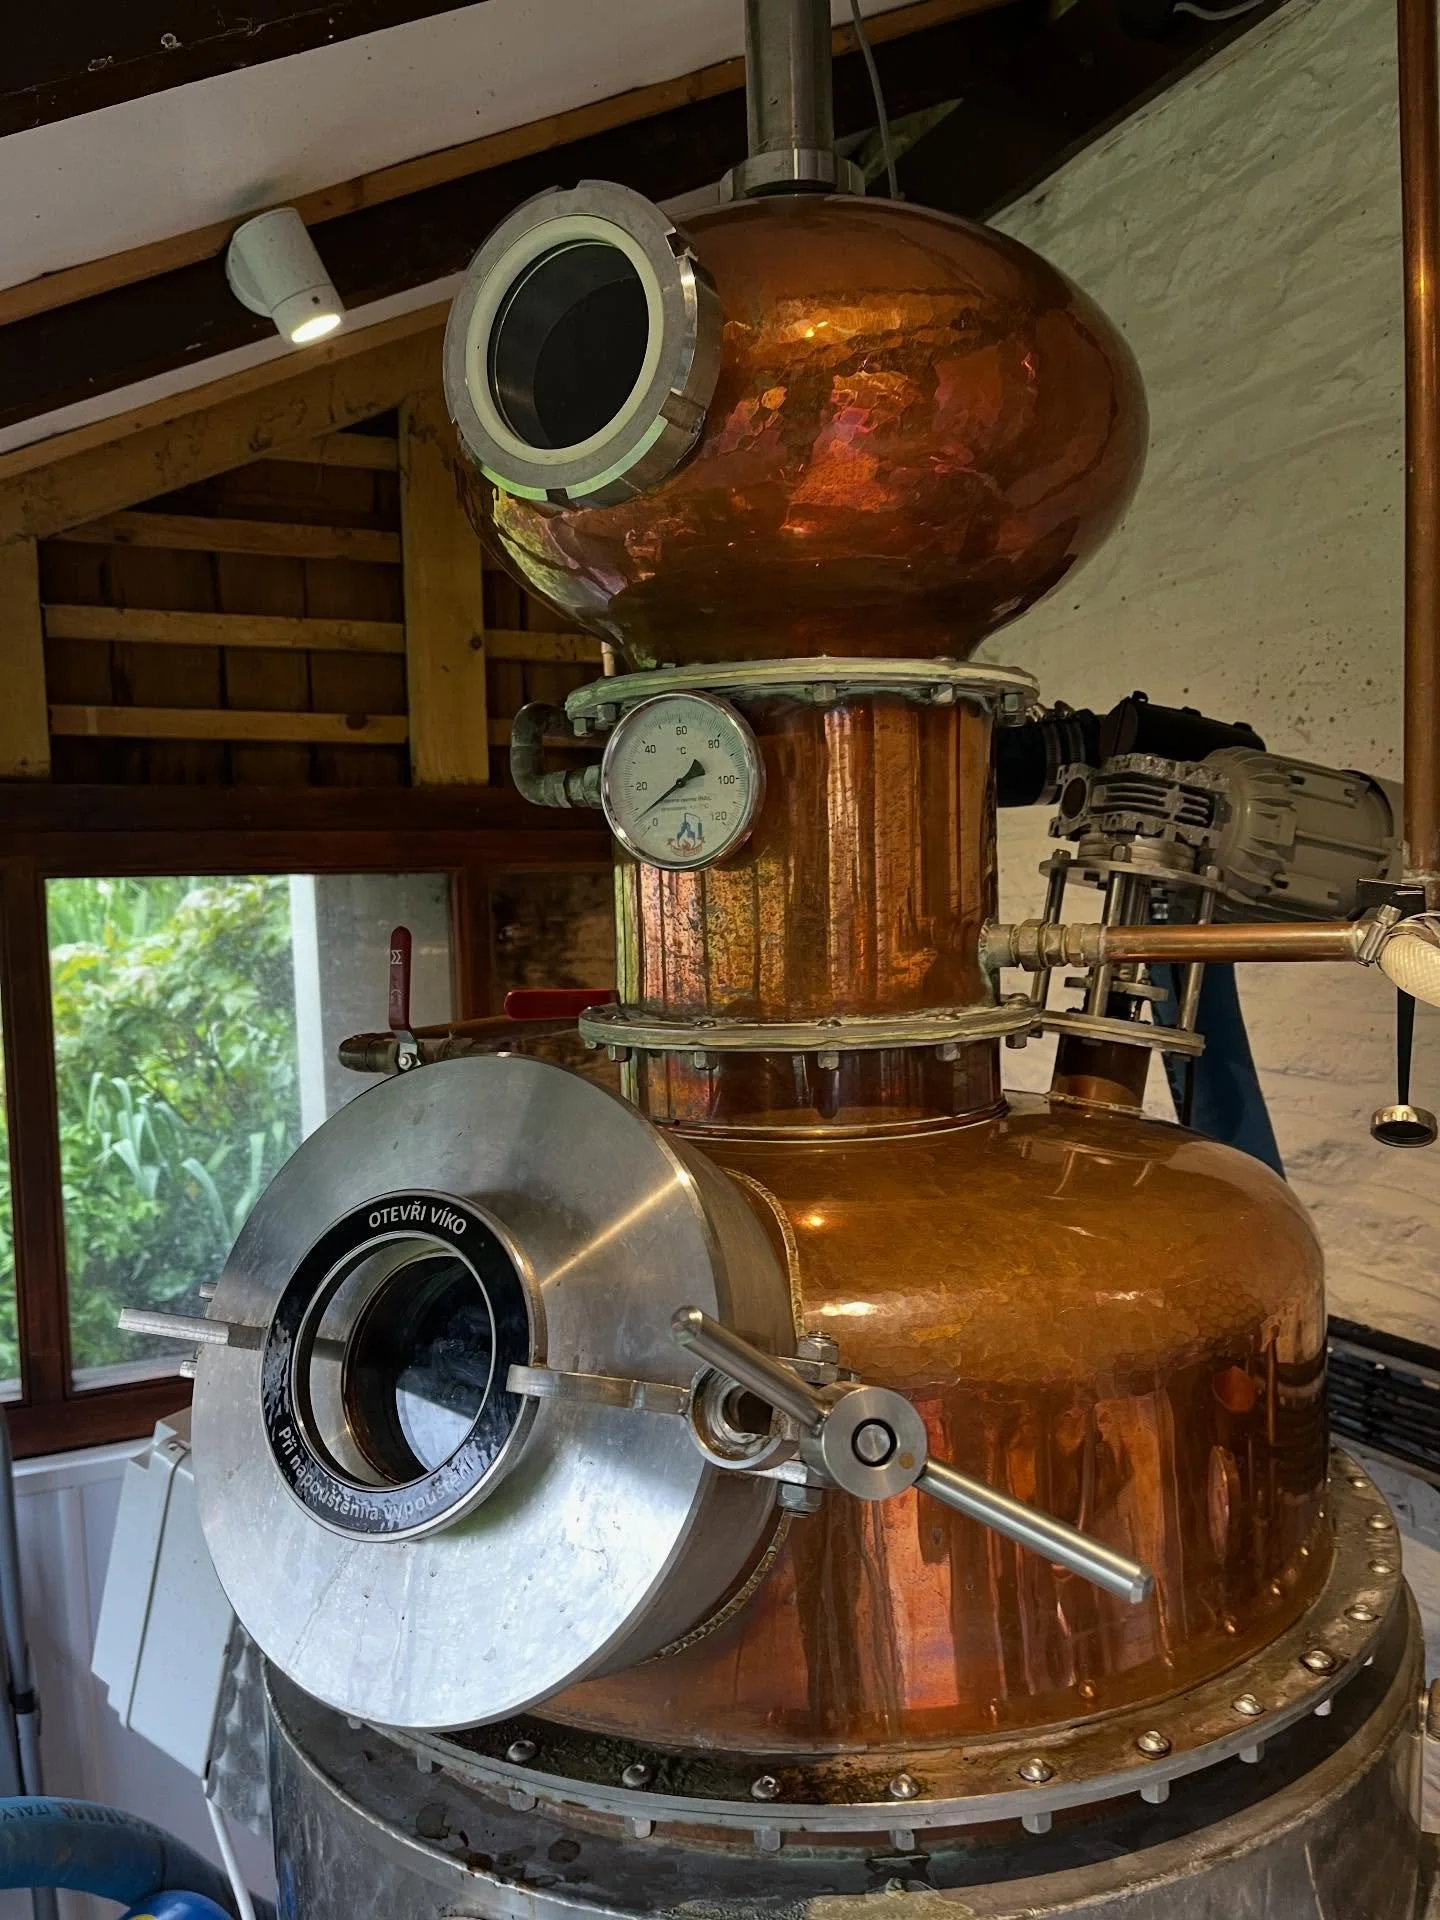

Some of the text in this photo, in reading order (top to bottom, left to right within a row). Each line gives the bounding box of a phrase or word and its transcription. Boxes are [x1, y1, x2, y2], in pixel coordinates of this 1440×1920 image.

[676, 725, 688, 736] 60
[644, 744, 656, 754] 40
[708, 739, 720, 749] 80
[718, 775, 735, 785] 100
[636, 781, 648, 791] 20
[711, 811, 727, 821] 120
[652, 817, 659, 827] 0
[368, 1200, 467, 1235] OTEVŘI VÍKO
[278, 1426, 298, 1456] Při
